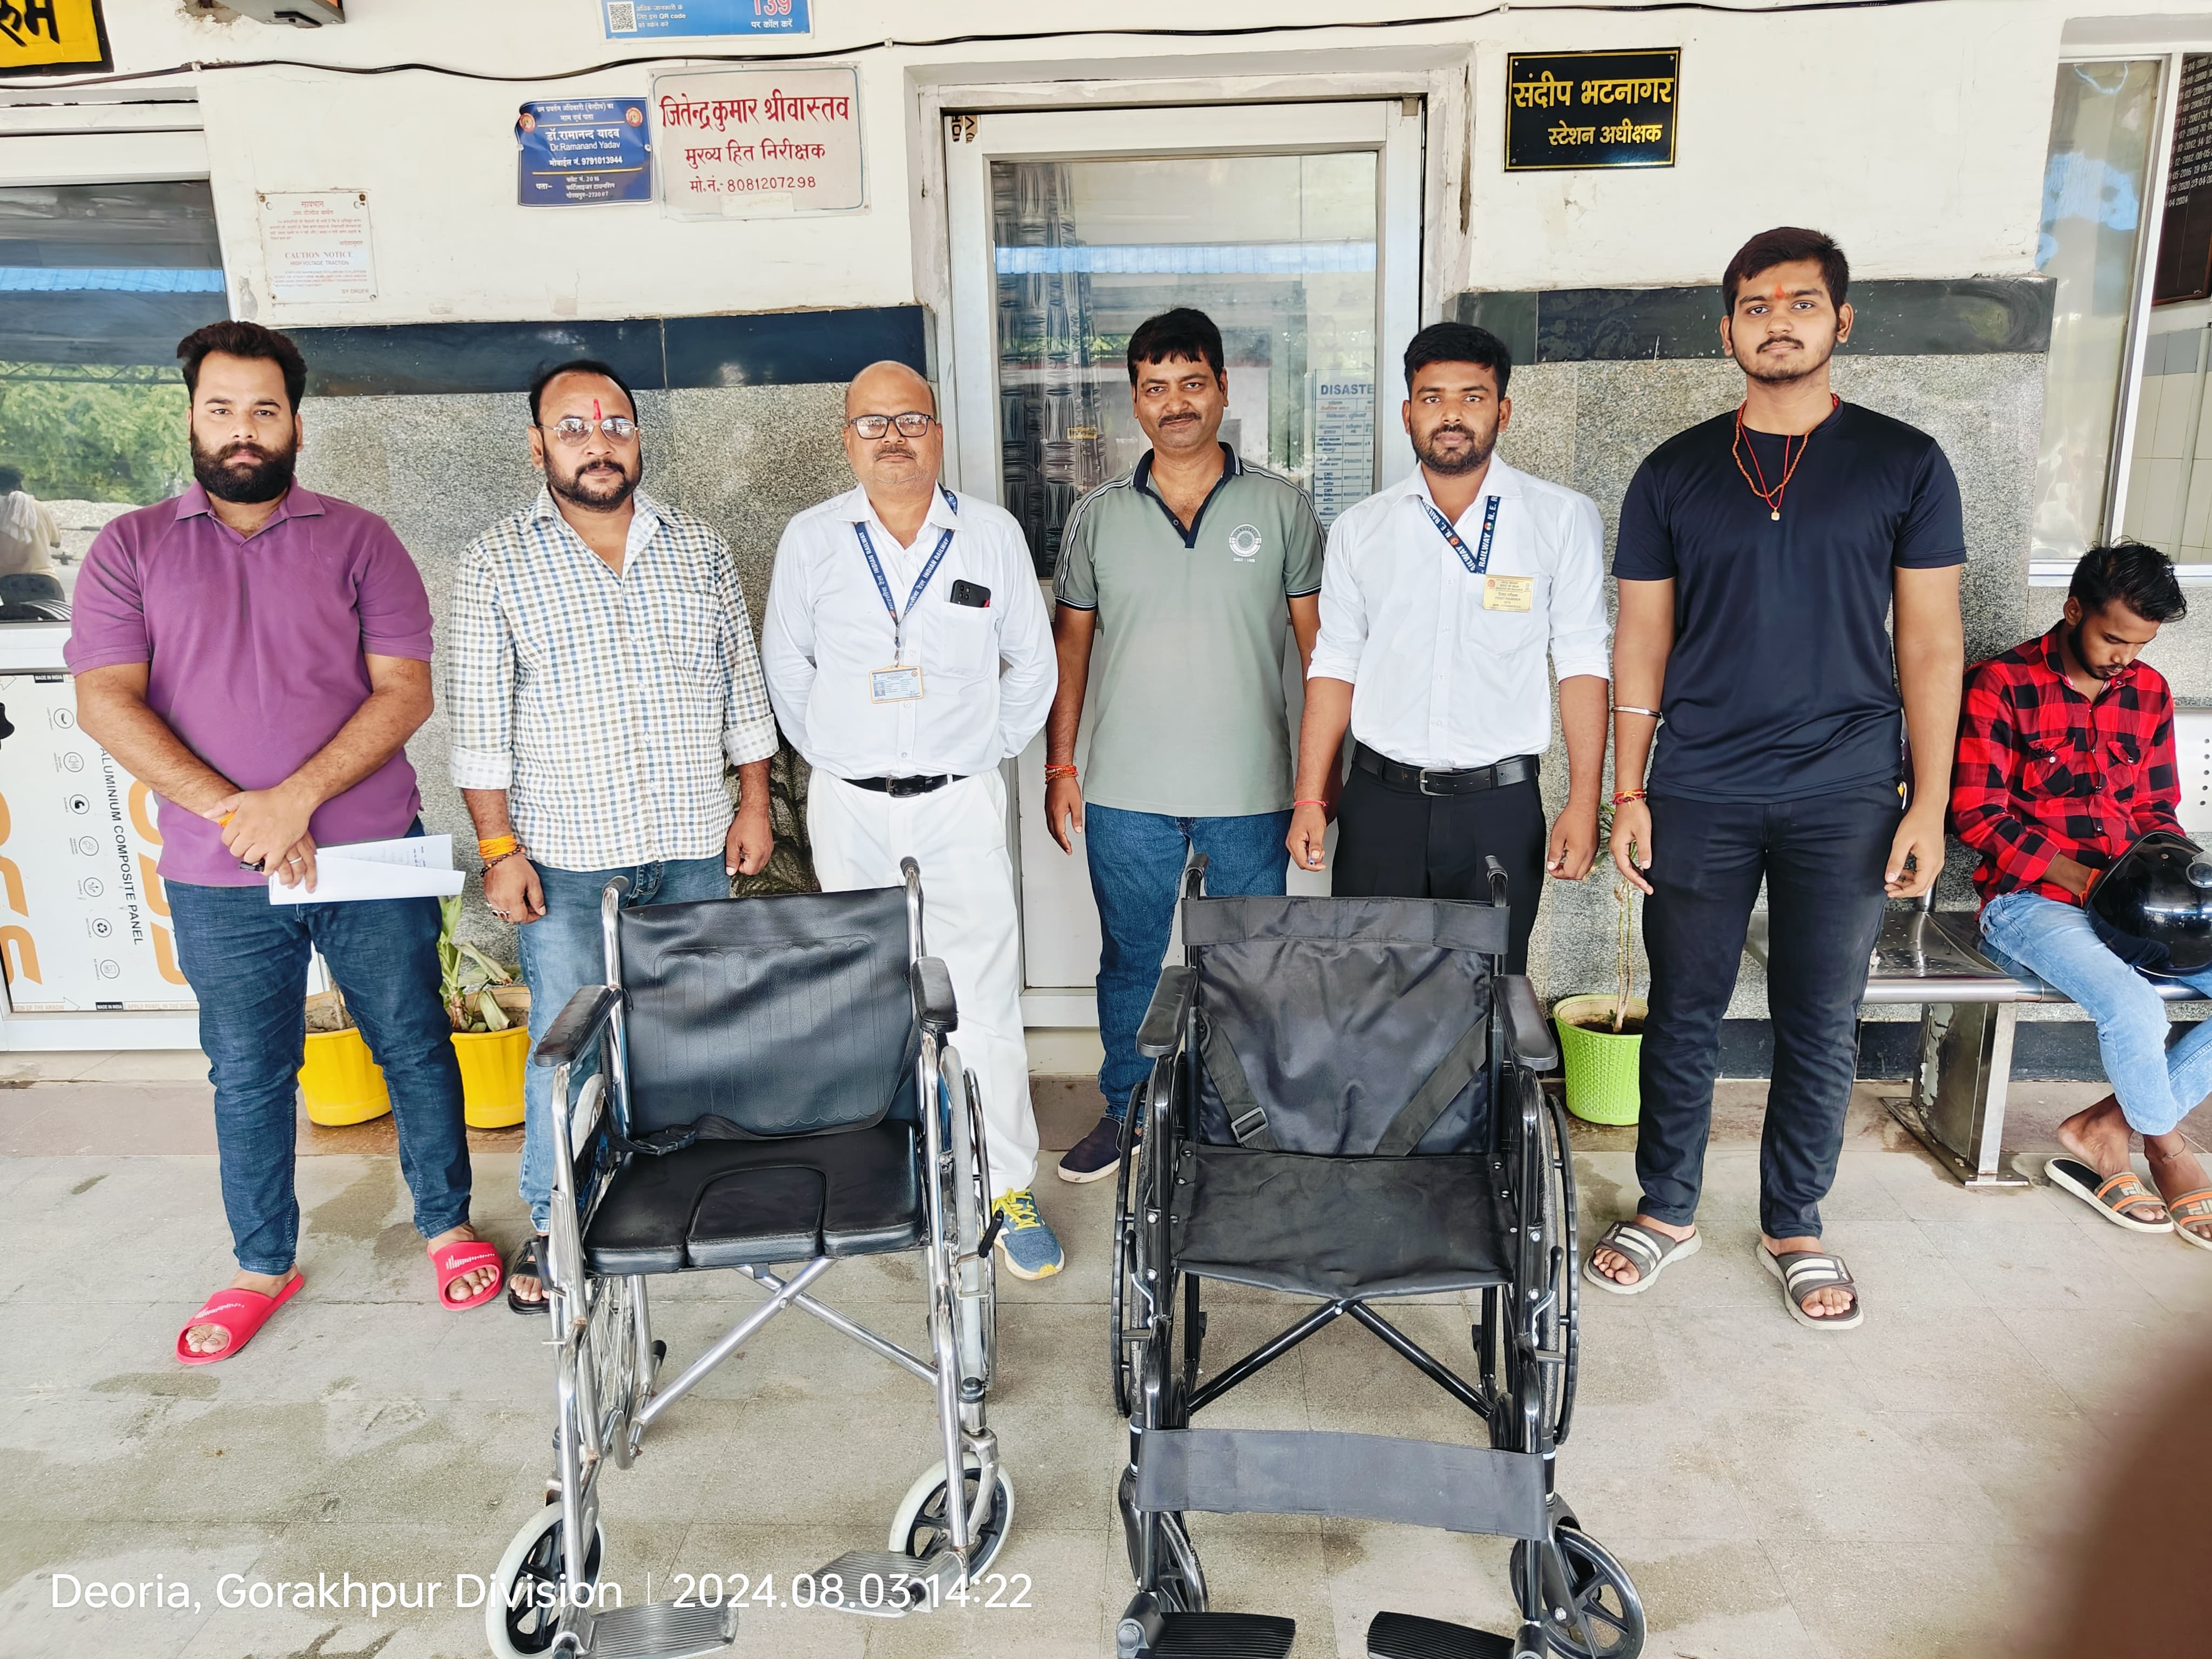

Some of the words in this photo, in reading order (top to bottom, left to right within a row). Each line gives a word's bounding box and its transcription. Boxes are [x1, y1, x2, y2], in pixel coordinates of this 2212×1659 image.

[763, 19, 779, 28] कॉल
[780, 18, 793, 27] करें
[1513, 70, 1573, 109] संदीप
[1581, 77, 1674, 105] भटनागर
[765, 89, 850, 123] श्रीवास्तव
[573, 114, 581, 123] एवं
[596, 128, 620, 138] यादव
[1548, 120, 1596, 146] स्टेशन
[1600, 118, 1663, 144] अधीक्षक
[550, 141, 597, 152] Dr.Ramanand
[599, 141, 621, 150] Yadav
[726, 139, 755, 167] हित
[760, 138, 825, 161] निरीक्षक
[582, 156, 623, 165] 9791013944
[727, 176, 817, 192] 8081207298
[859, 532, 872, 555] RAILWAY
[1478, 532, 1491, 568] RAILWAY
[868, 555, 880, 574] INDIAN
[923, 559, 938, 579] INDIAN
[934, 537, 949, 561] RAILWAY
[100, 747, 122, 821] ALUMINIUM
[113, 825, 136, 901] COMPOSITE
[128, 905, 143, 945] PANEL
